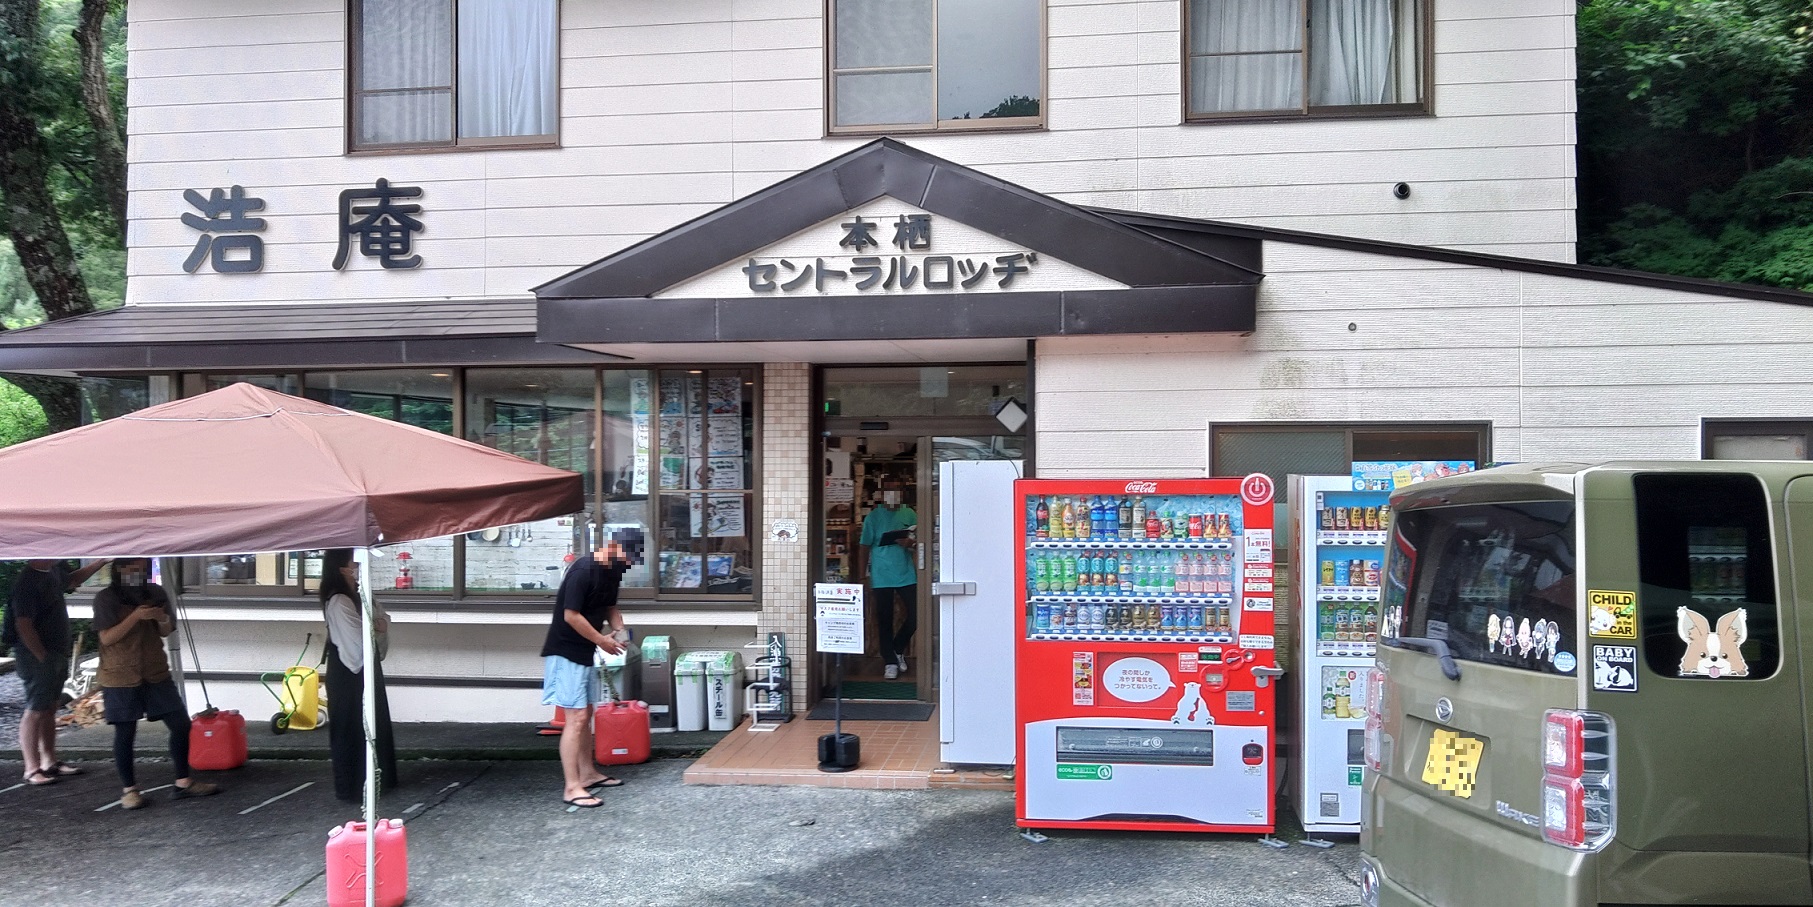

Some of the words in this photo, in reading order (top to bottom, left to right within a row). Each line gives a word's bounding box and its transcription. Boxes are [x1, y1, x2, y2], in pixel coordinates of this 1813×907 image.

[180, 177, 425, 274] 浩庵
[839, 214, 932, 251] 本栖
[742, 252, 1038, 292] セントラルロッヂ
[1592, 594, 1631, 605] CHILD
[1609, 625, 1632, 635] CAR
[1596, 647, 1633, 657] BABY
[714, 678, 724, 716] スチール缶
